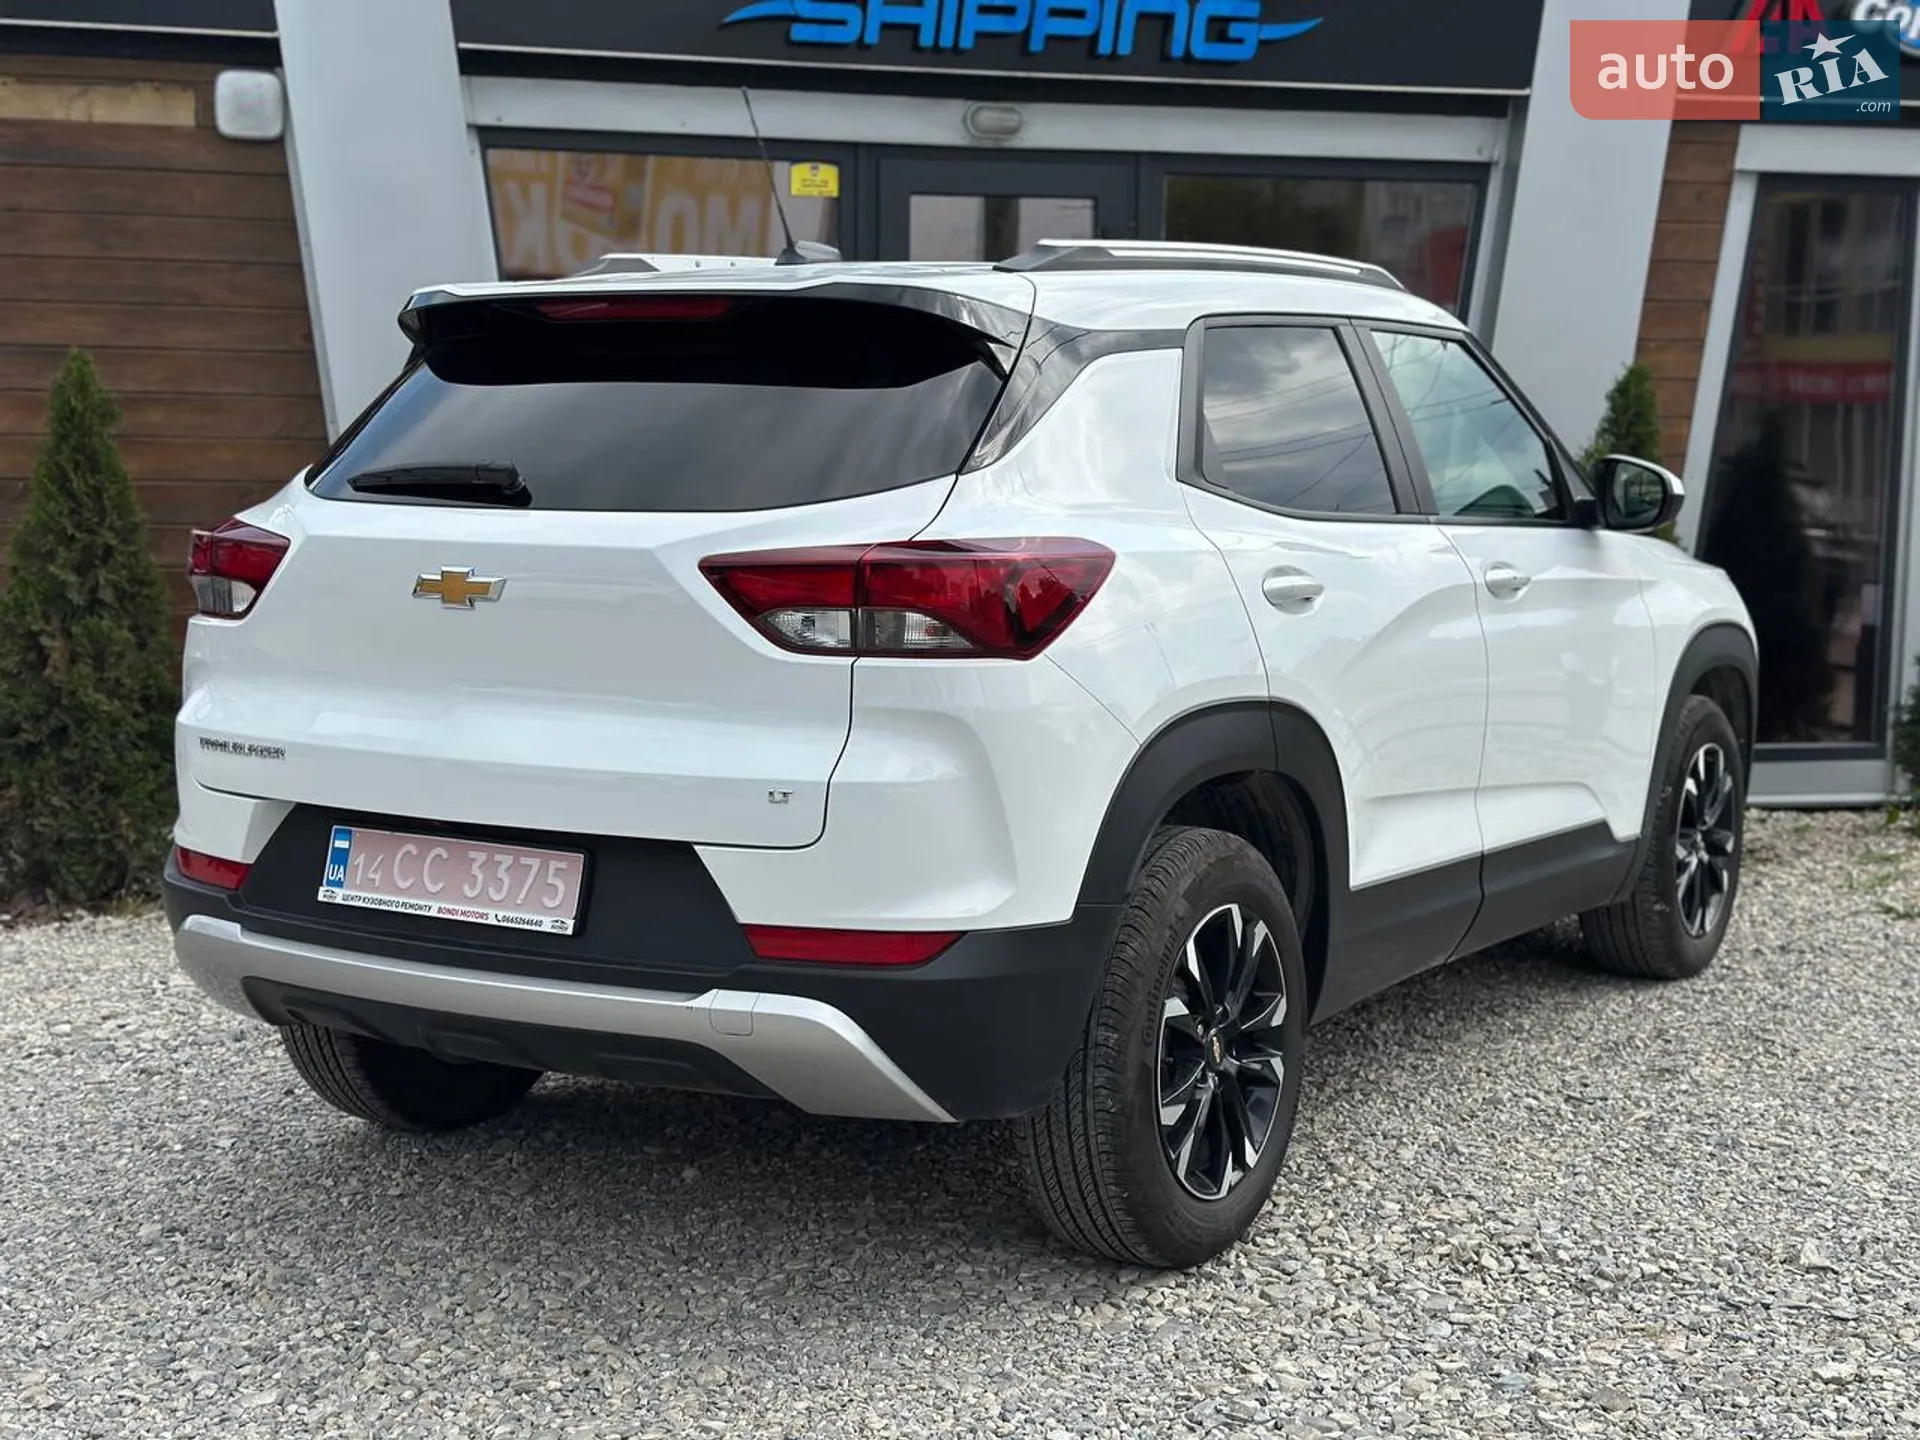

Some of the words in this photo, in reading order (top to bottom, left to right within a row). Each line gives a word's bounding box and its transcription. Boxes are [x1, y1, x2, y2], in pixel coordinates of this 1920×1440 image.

[789, 0, 1261, 61] SHIPPING
[328, 864, 345, 881] UA
[353, 852, 384, 888] 14
[392, 843, 448, 894] CC
[463, 851, 568, 909] 3375
[341, 894, 362, 903] ЦЕНТР
[400, 901, 433, 913] РЕМОНТУ
[437, 906, 460, 917] BONDI
[460, 908, 490, 921] MOTORS
[1141, 924, 1179, 1046] Continental
